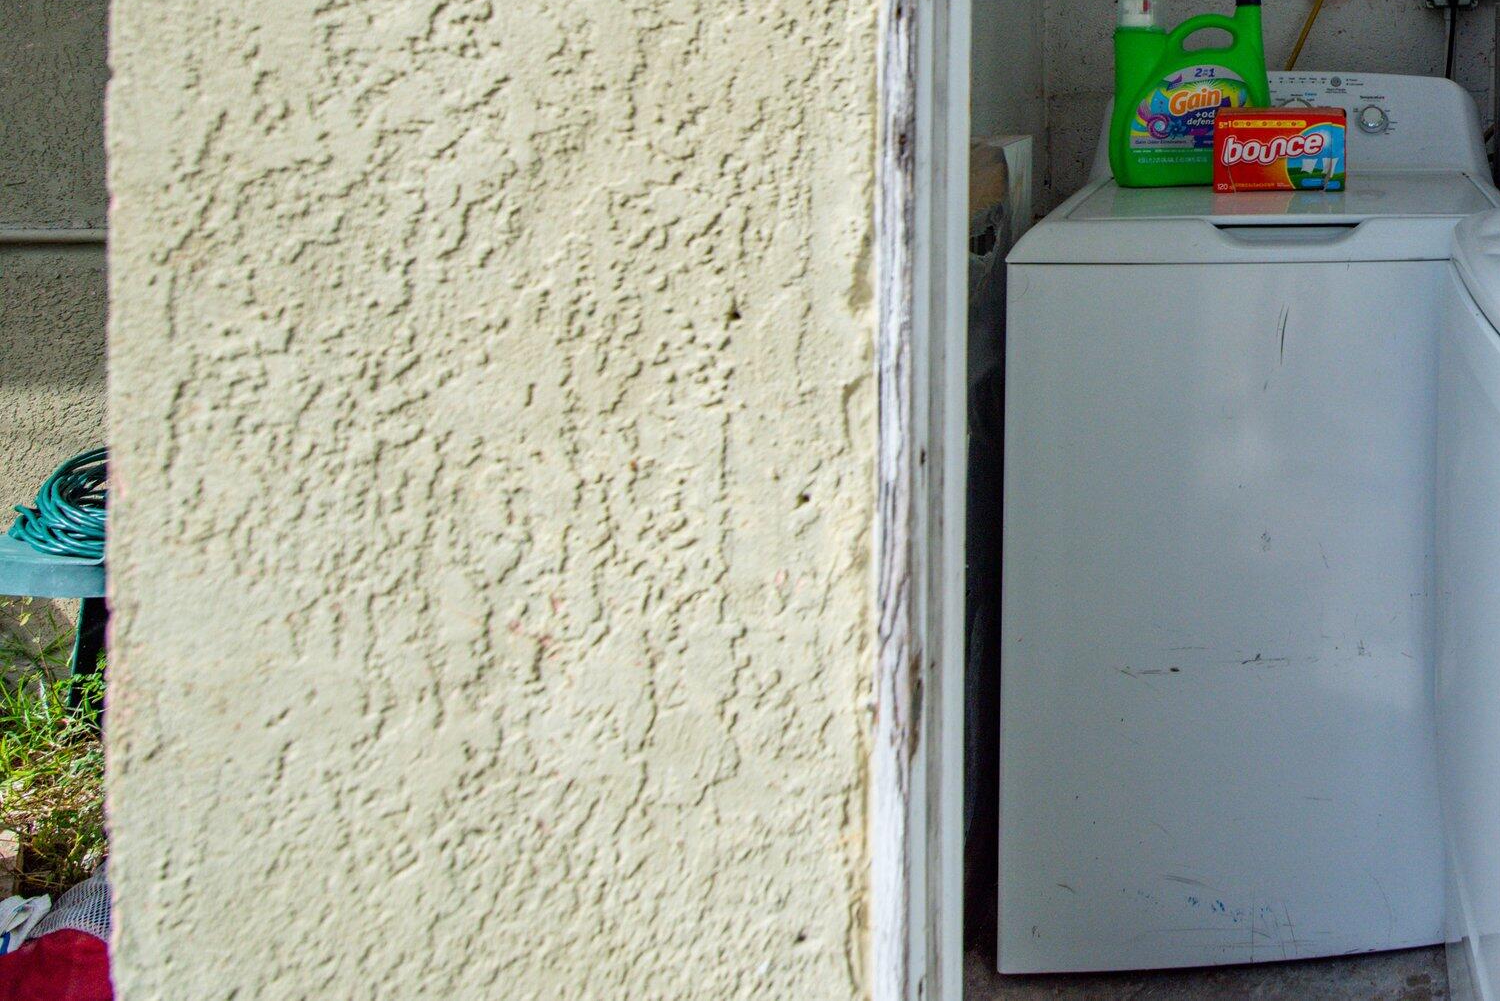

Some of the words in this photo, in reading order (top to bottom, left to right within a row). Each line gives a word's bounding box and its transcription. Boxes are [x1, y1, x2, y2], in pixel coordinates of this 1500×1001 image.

[1169, 87, 1221, 116] Gain
[1186, 117, 1215, 127] defens
[1195, 109, 1215, 118] +od
[1222, 133, 1324, 165] bounce
